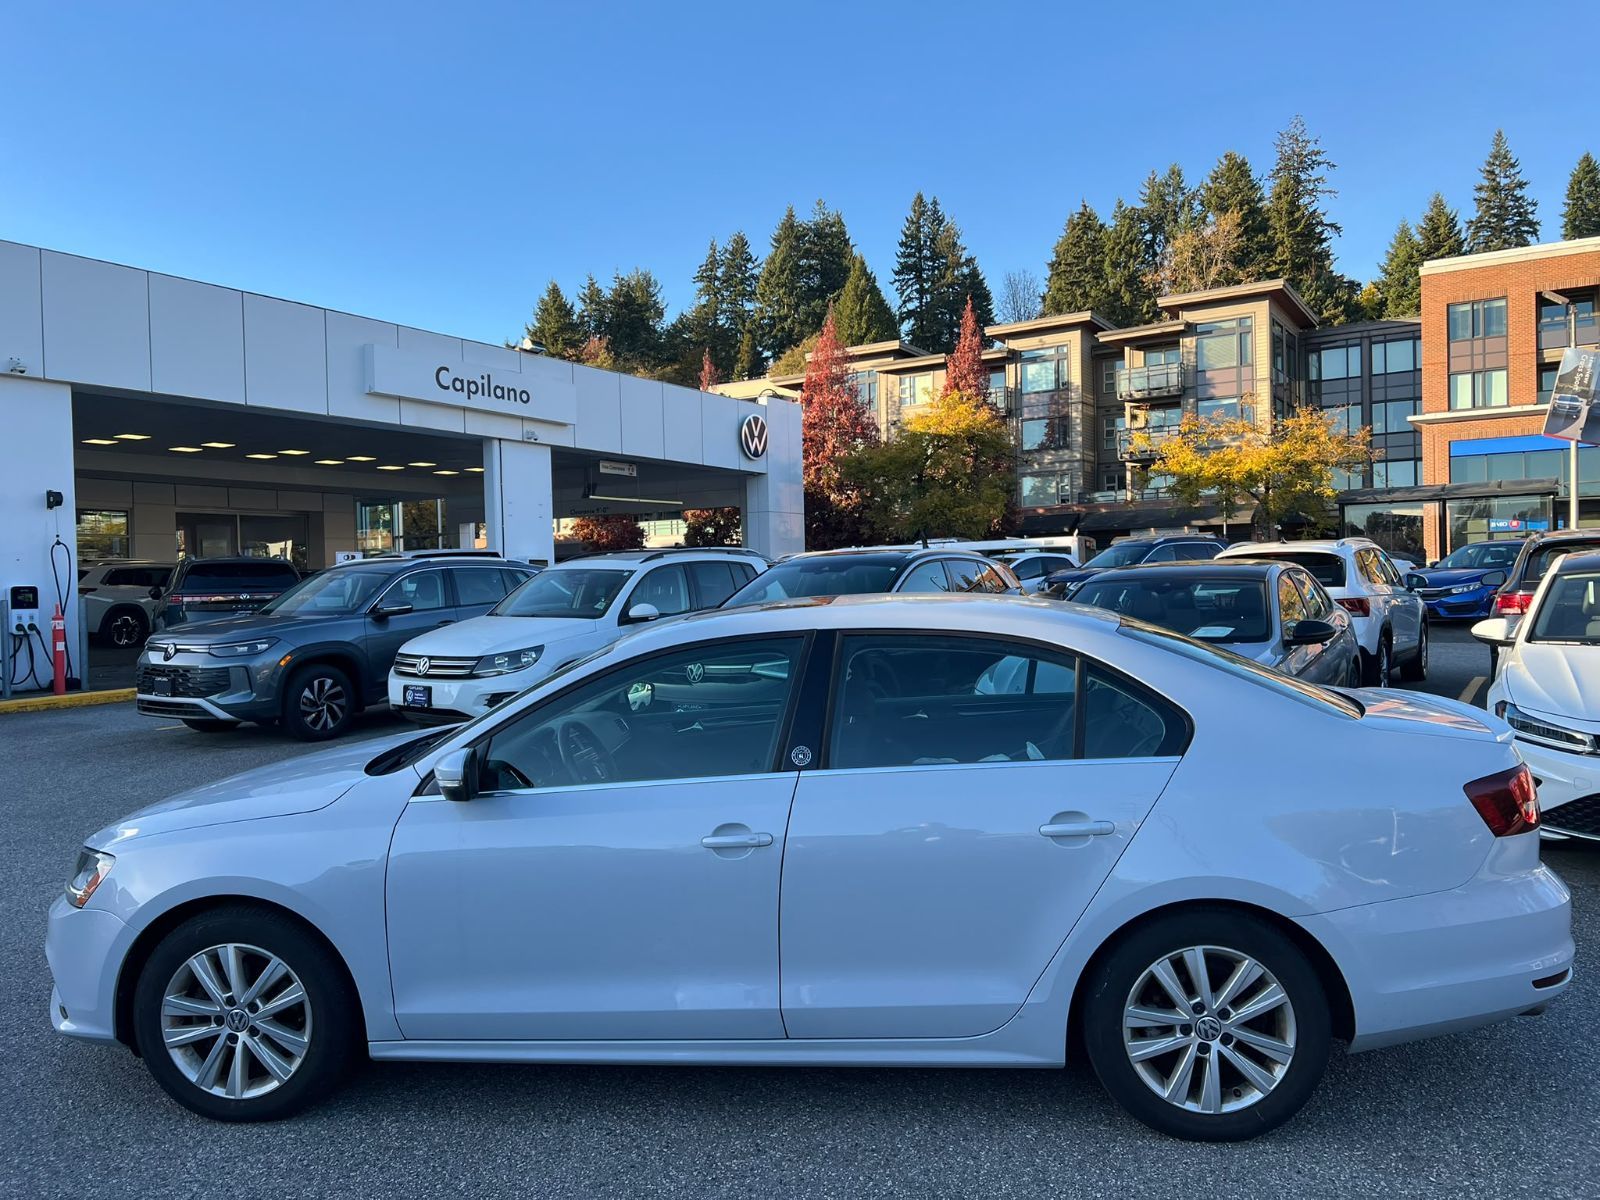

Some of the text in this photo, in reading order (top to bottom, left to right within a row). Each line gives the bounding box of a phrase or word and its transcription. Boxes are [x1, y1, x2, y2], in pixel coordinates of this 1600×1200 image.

[435, 366, 531, 404] Capilano
[742, 414, 768, 459] VW
[227, 1009, 248, 1031] VW
[1196, 1016, 1220, 1040] VW
